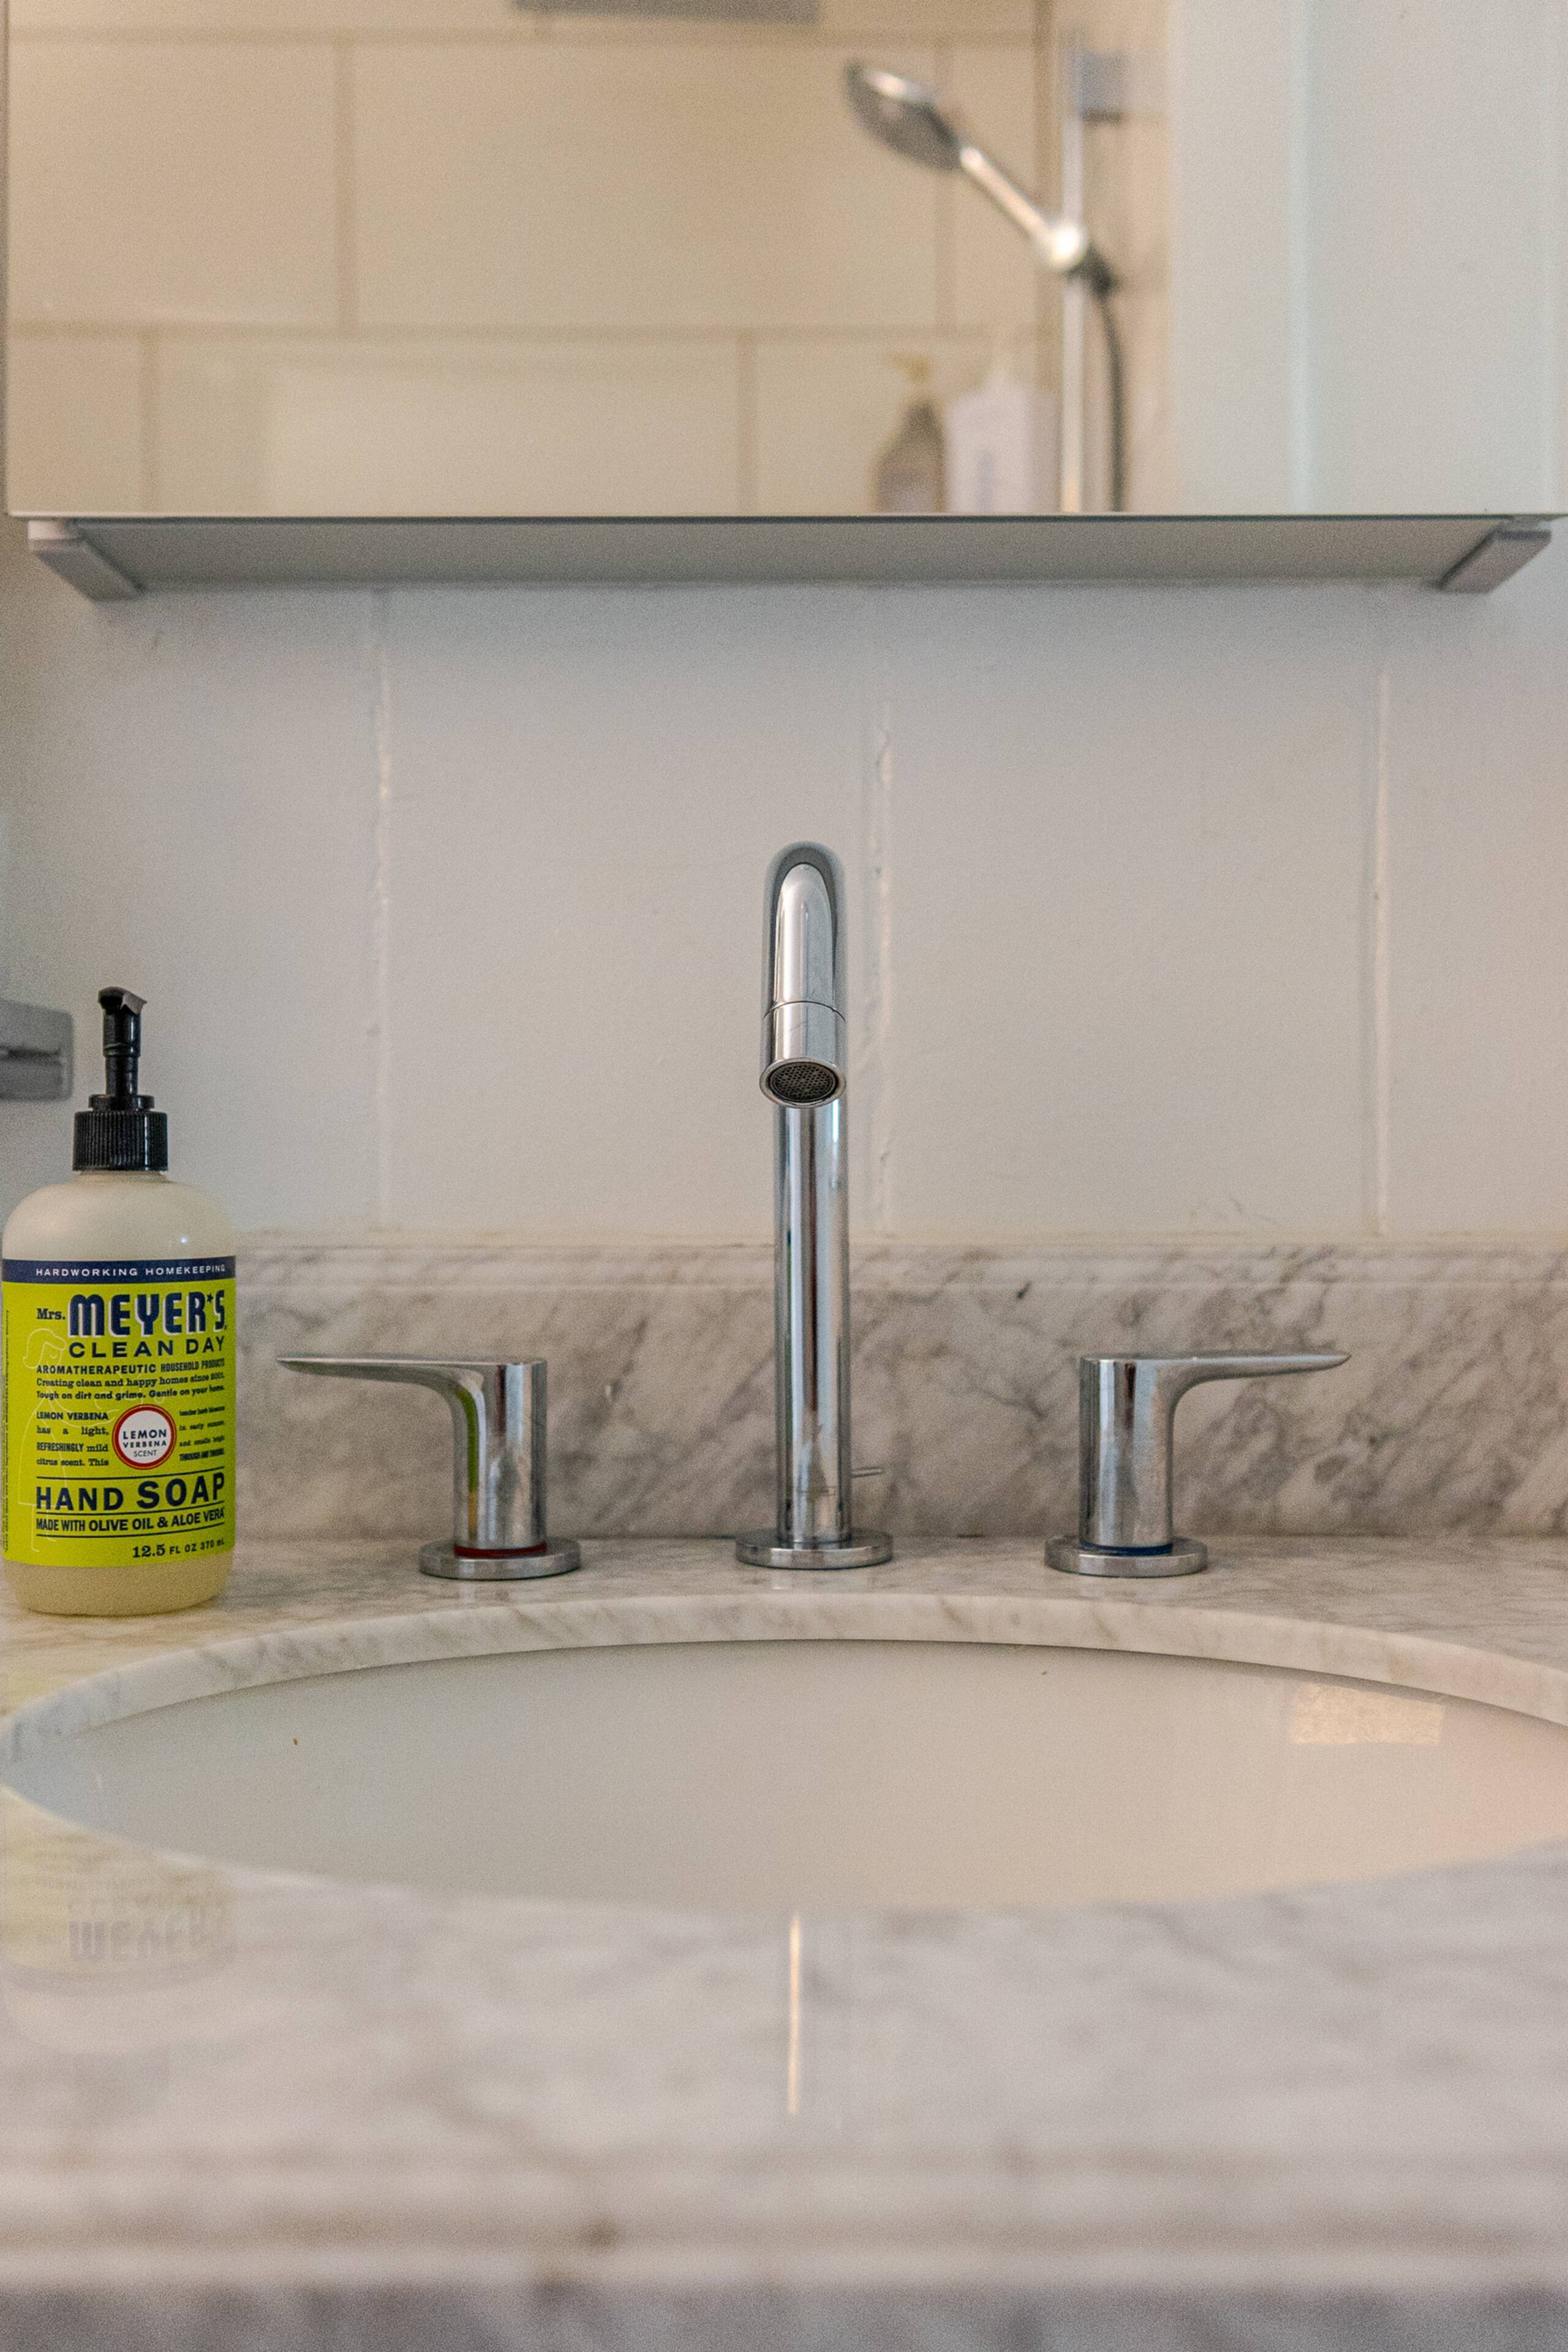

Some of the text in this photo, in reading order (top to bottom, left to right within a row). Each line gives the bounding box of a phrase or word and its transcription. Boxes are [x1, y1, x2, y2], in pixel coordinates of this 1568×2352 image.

[146, 1265, 225, 1275] HOMEKEEPING
[37, 1308, 66, 1320] Mrs.
[69, 1336, 224, 1358] CLEAN DAY
[37, 1364, 156, 1374] AROMATHERAPEUTIC
[160, 1361, 198, 1372] HOUSEHOLD
[37, 1378, 74, 1388] Creating
[127, 1378, 157, 1388] happy
[37, 1391, 59, 1400] Tough
[94, 1391, 112, 1399] and
[116, 1391, 146, 1401] grime.
[149, 1388, 178, 1397] Gentle
[192, 1387, 208, 1396] your
[37, 1425, 51, 1434] has
[123, 1429, 167, 1439] LEMON
[37, 1442, 109, 1452] REFRESHINGLY mild
[36, 1472, 224, 1511] HAND SOAP
[37, 1518, 59, 1530] MADE
[61, 1519, 85, 1531] WITH
[89, 1519, 128, 1531] OLIVE
[132, 1518, 154, 1530] OIL
[157, 1516, 168, 1528] &
[171, 1512, 200, 1527] ALOE
[132, 1544, 165, 1557] 12.5
[170, 1546, 180, 1554] FL
[185, 1543, 197, 1552] OZ
[200, 1540, 214, 1550] 370
